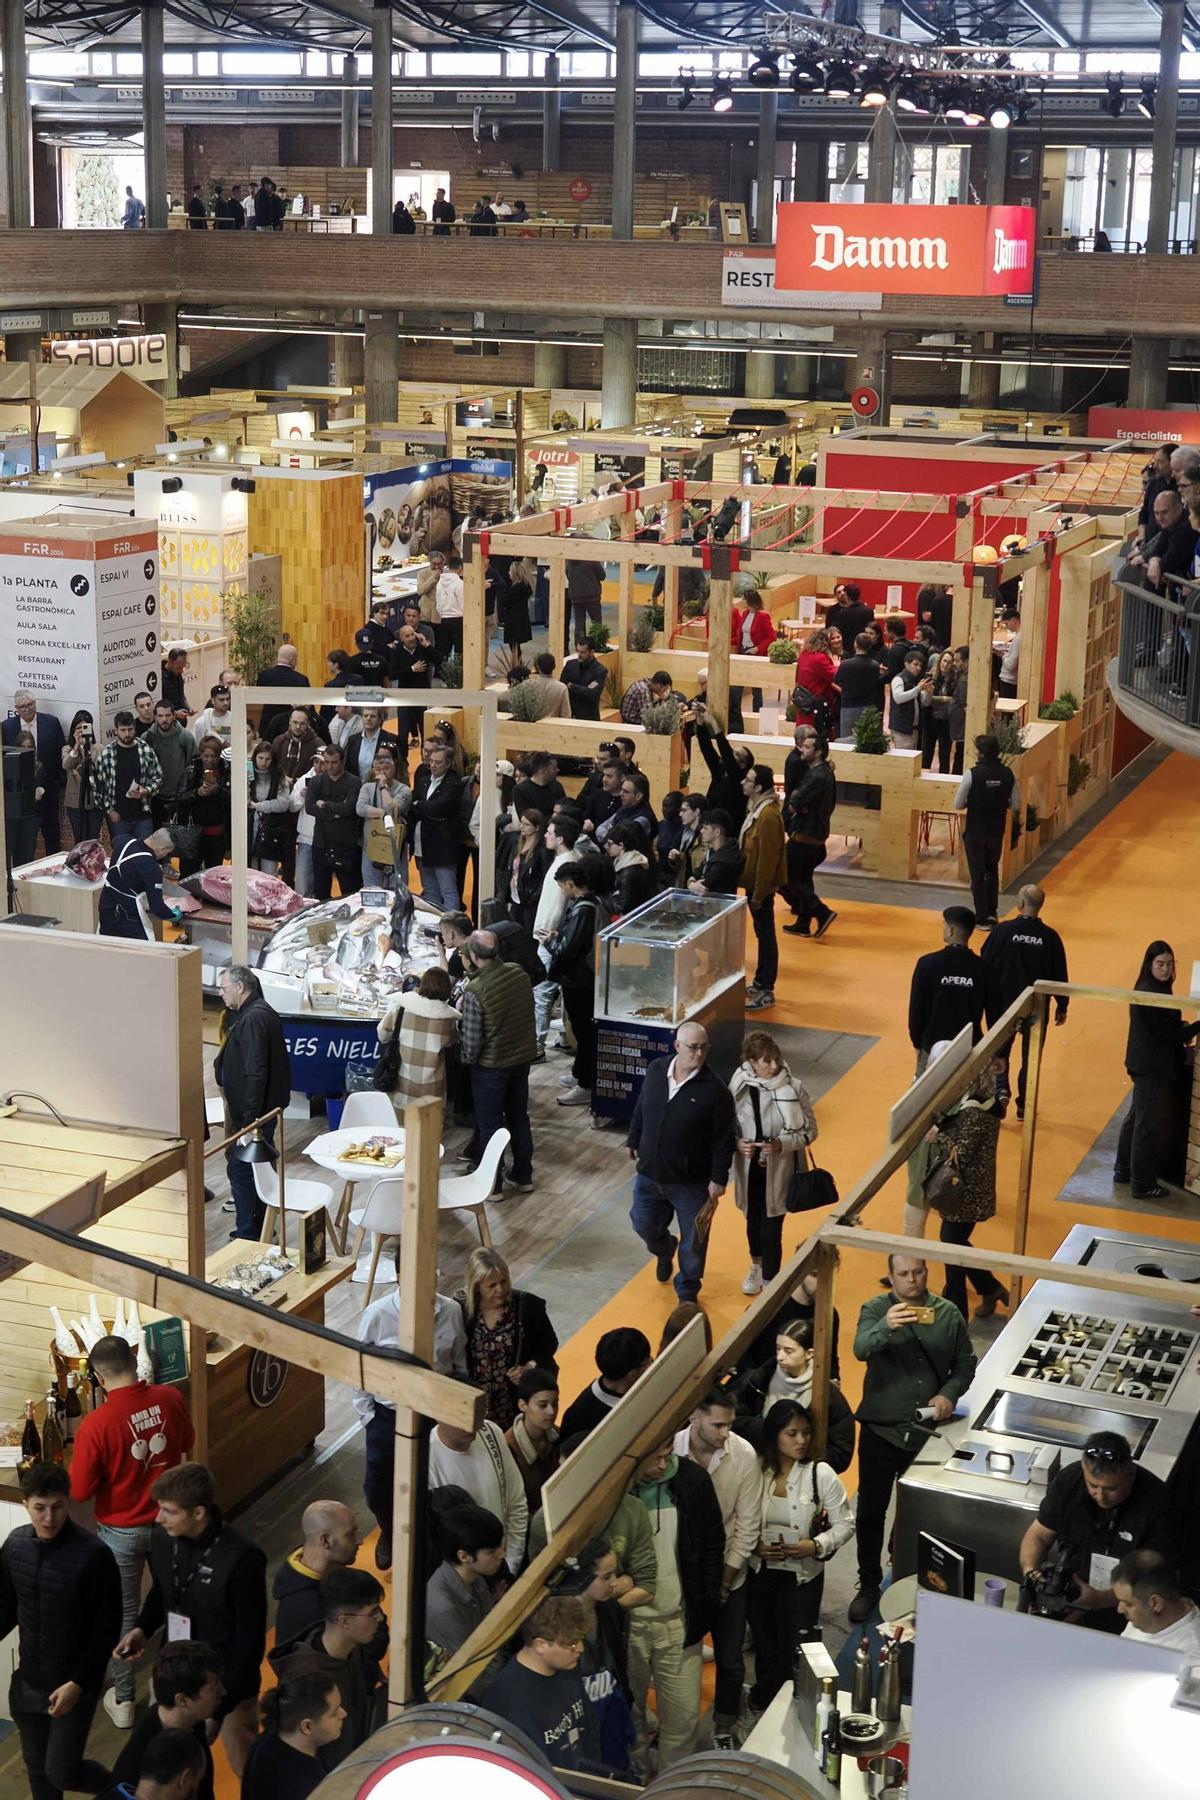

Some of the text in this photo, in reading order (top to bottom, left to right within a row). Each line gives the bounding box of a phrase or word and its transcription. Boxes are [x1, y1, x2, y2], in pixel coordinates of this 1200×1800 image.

[810, 223, 950, 272] Damm
[993, 228, 1028, 274] Damm
[727, 271, 776, 288] REST
[1116, 429, 1183, 442] Especialistas
[160, 513, 197, 523] BLISS
[2, 575, 59, 589] 1a PLANTA
[100, 569, 129, 584] ESPAI VI
[15, 595, 26, 603] LA
[101, 607, 122, 621] ESPAI
[17, 622, 57, 631] AULA SALA
[17, 638, 46, 647] GIRONA
[103, 637, 136, 653] AUDITORI
[17, 655, 66, 665] RESTAURANT
[17, 672, 59, 681] CAFETERIA
[18, 681, 56, 690] TERRASSA
[104, 677, 135, 693] SORTIDA
[104, 693, 120, 705] EXIT
[7, 710, 20, 719] ES
[635, 1067, 647, 1076] CAN
